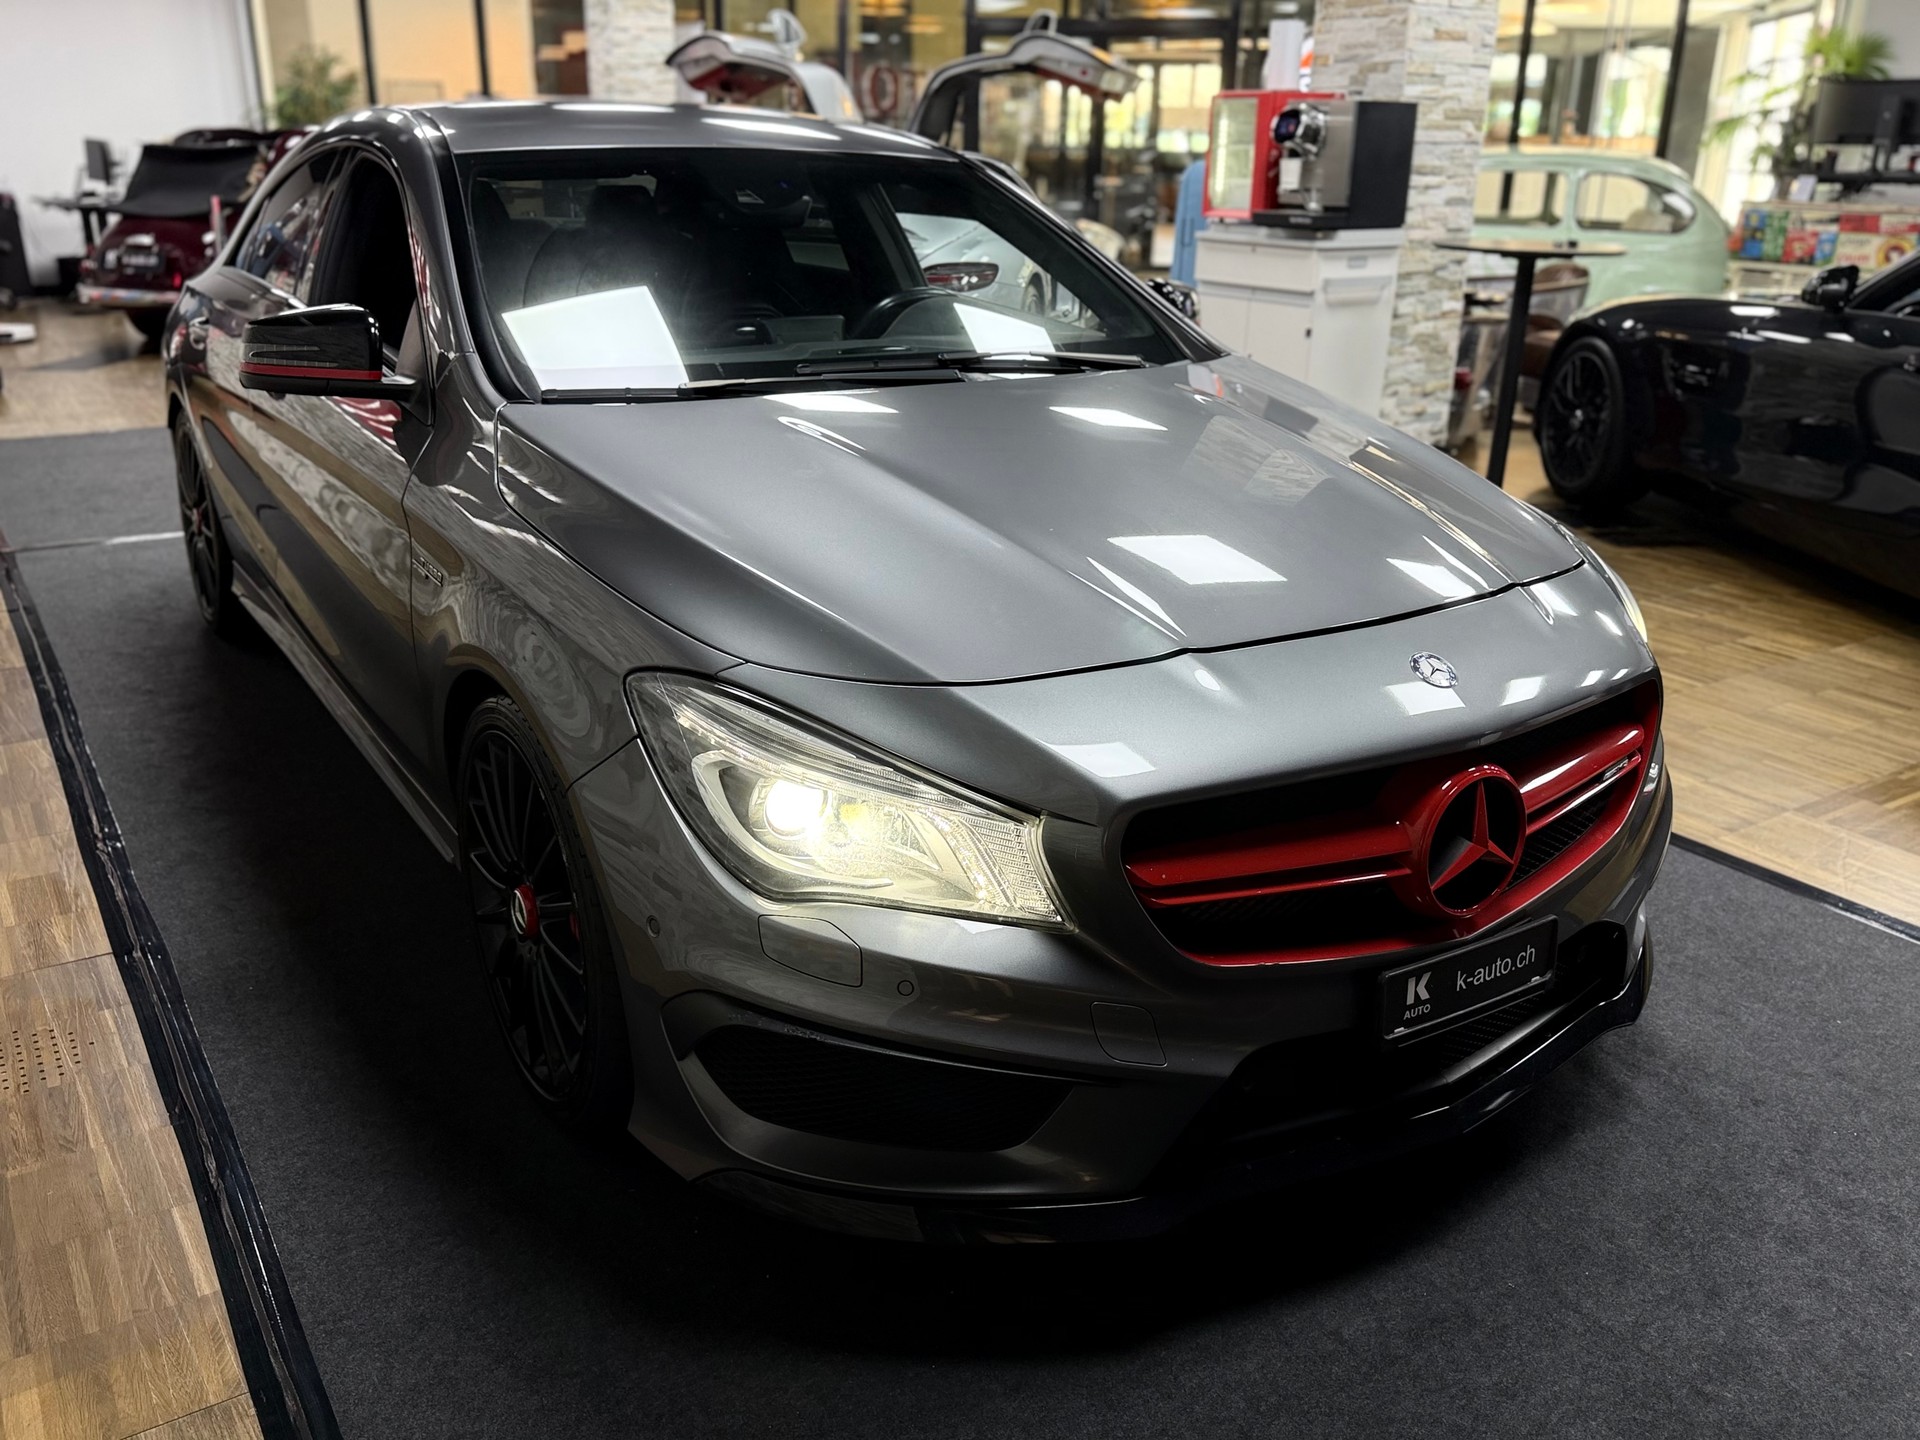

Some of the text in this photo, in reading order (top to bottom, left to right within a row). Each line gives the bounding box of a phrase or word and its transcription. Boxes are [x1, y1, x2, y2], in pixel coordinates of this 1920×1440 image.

[1456, 944, 1536, 992] k-auto.ch
[1406, 971, 1431, 1005] K
[1403, 1004, 1431, 1021] AUTO
